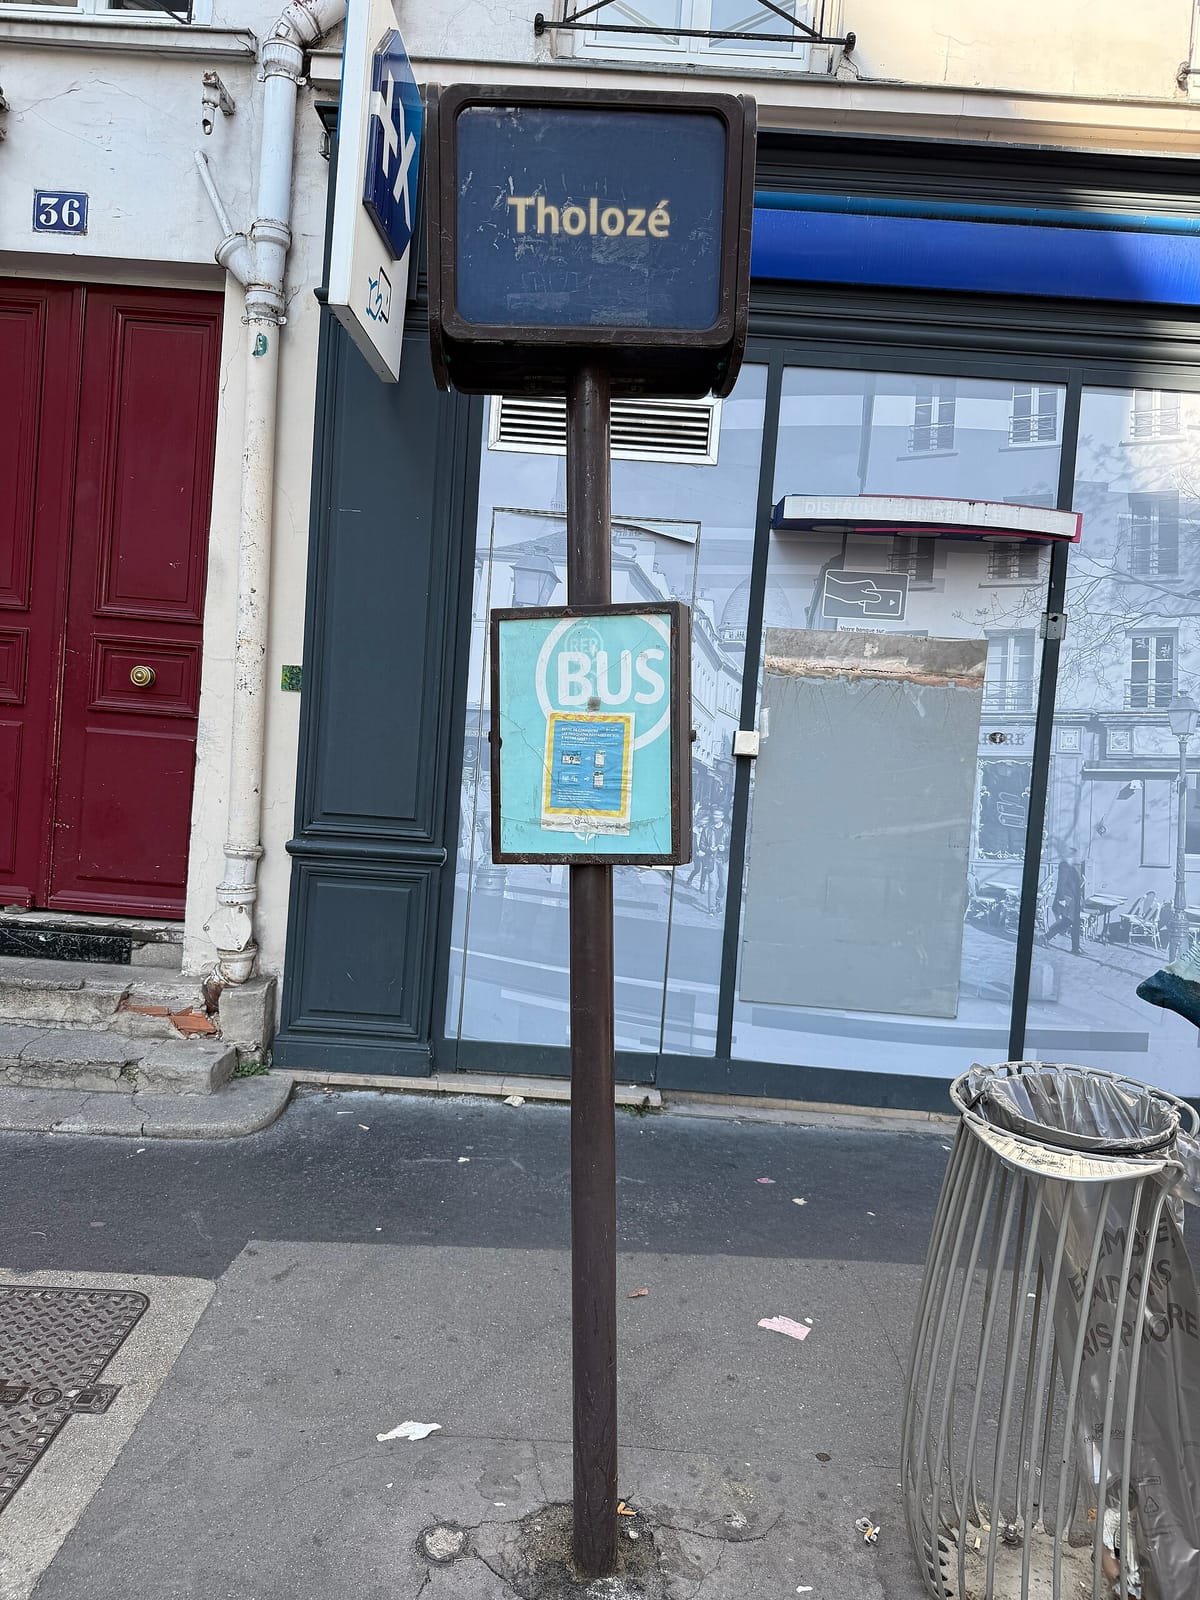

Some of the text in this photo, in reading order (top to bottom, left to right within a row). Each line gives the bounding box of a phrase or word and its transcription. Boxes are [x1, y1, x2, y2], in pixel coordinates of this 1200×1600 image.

[40, 197, 80, 227] 36
[507, 196, 670, 237] Tholozé
[557, 648, 666, 705] BUS
